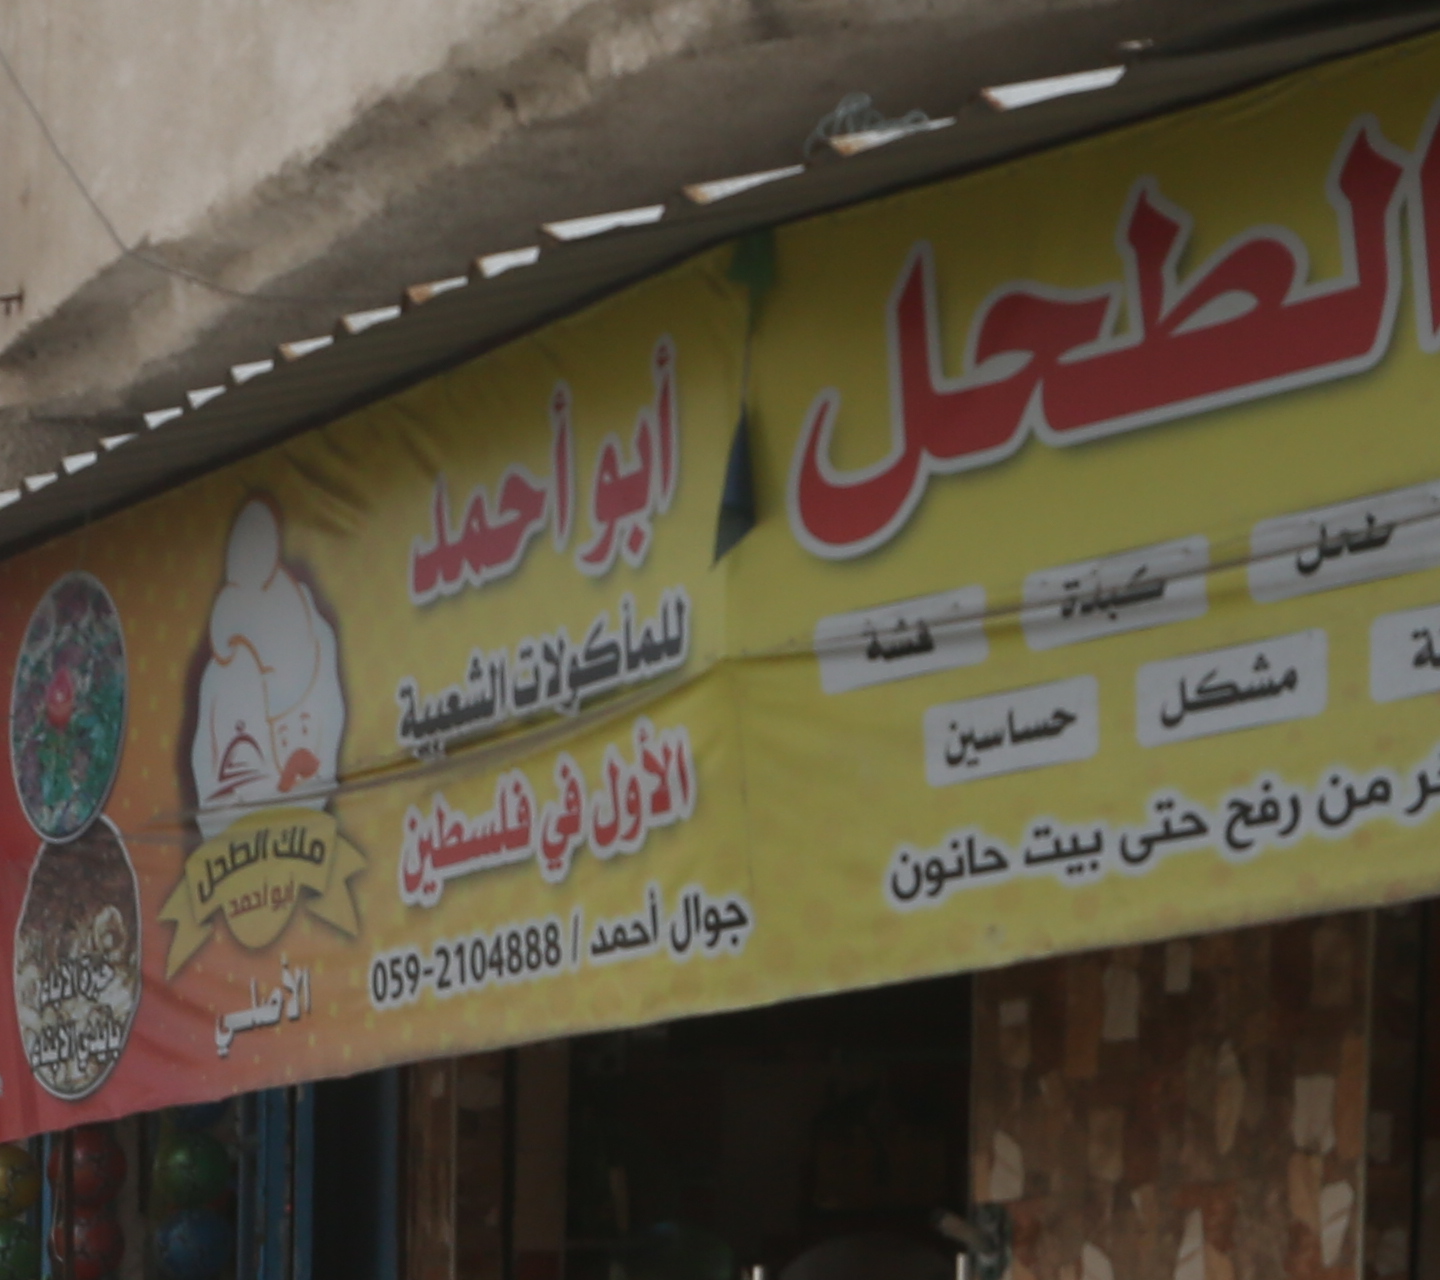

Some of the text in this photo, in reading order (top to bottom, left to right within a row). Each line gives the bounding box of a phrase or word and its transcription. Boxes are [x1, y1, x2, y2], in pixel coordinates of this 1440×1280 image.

[410, 339, 677, 602] أبو أحمد
[513, 599, 688, 716] للمأكولات
[1160, 653, 1298, 727] مشكل
[942, 703, 1078, 768] حساسين
[401, 720, 693, 903] الأول في فلسطين
[1121, 798, 1208, 861] حتى
[1226, 780, 1299, 850] رفح
[1318, 773, 1391, 826] من
[198, 829, 269, 903] الطحل
[890, 832, 1009, 900] حانون
[1023, 821, 1104, 873] بيت
[590, 910, 659, 958] أحمد
[675, 894, 749, 950] جوال
[371, 924, 562, 1003] 059-2104888
[215, 952, 311, 1058] الأصلي
